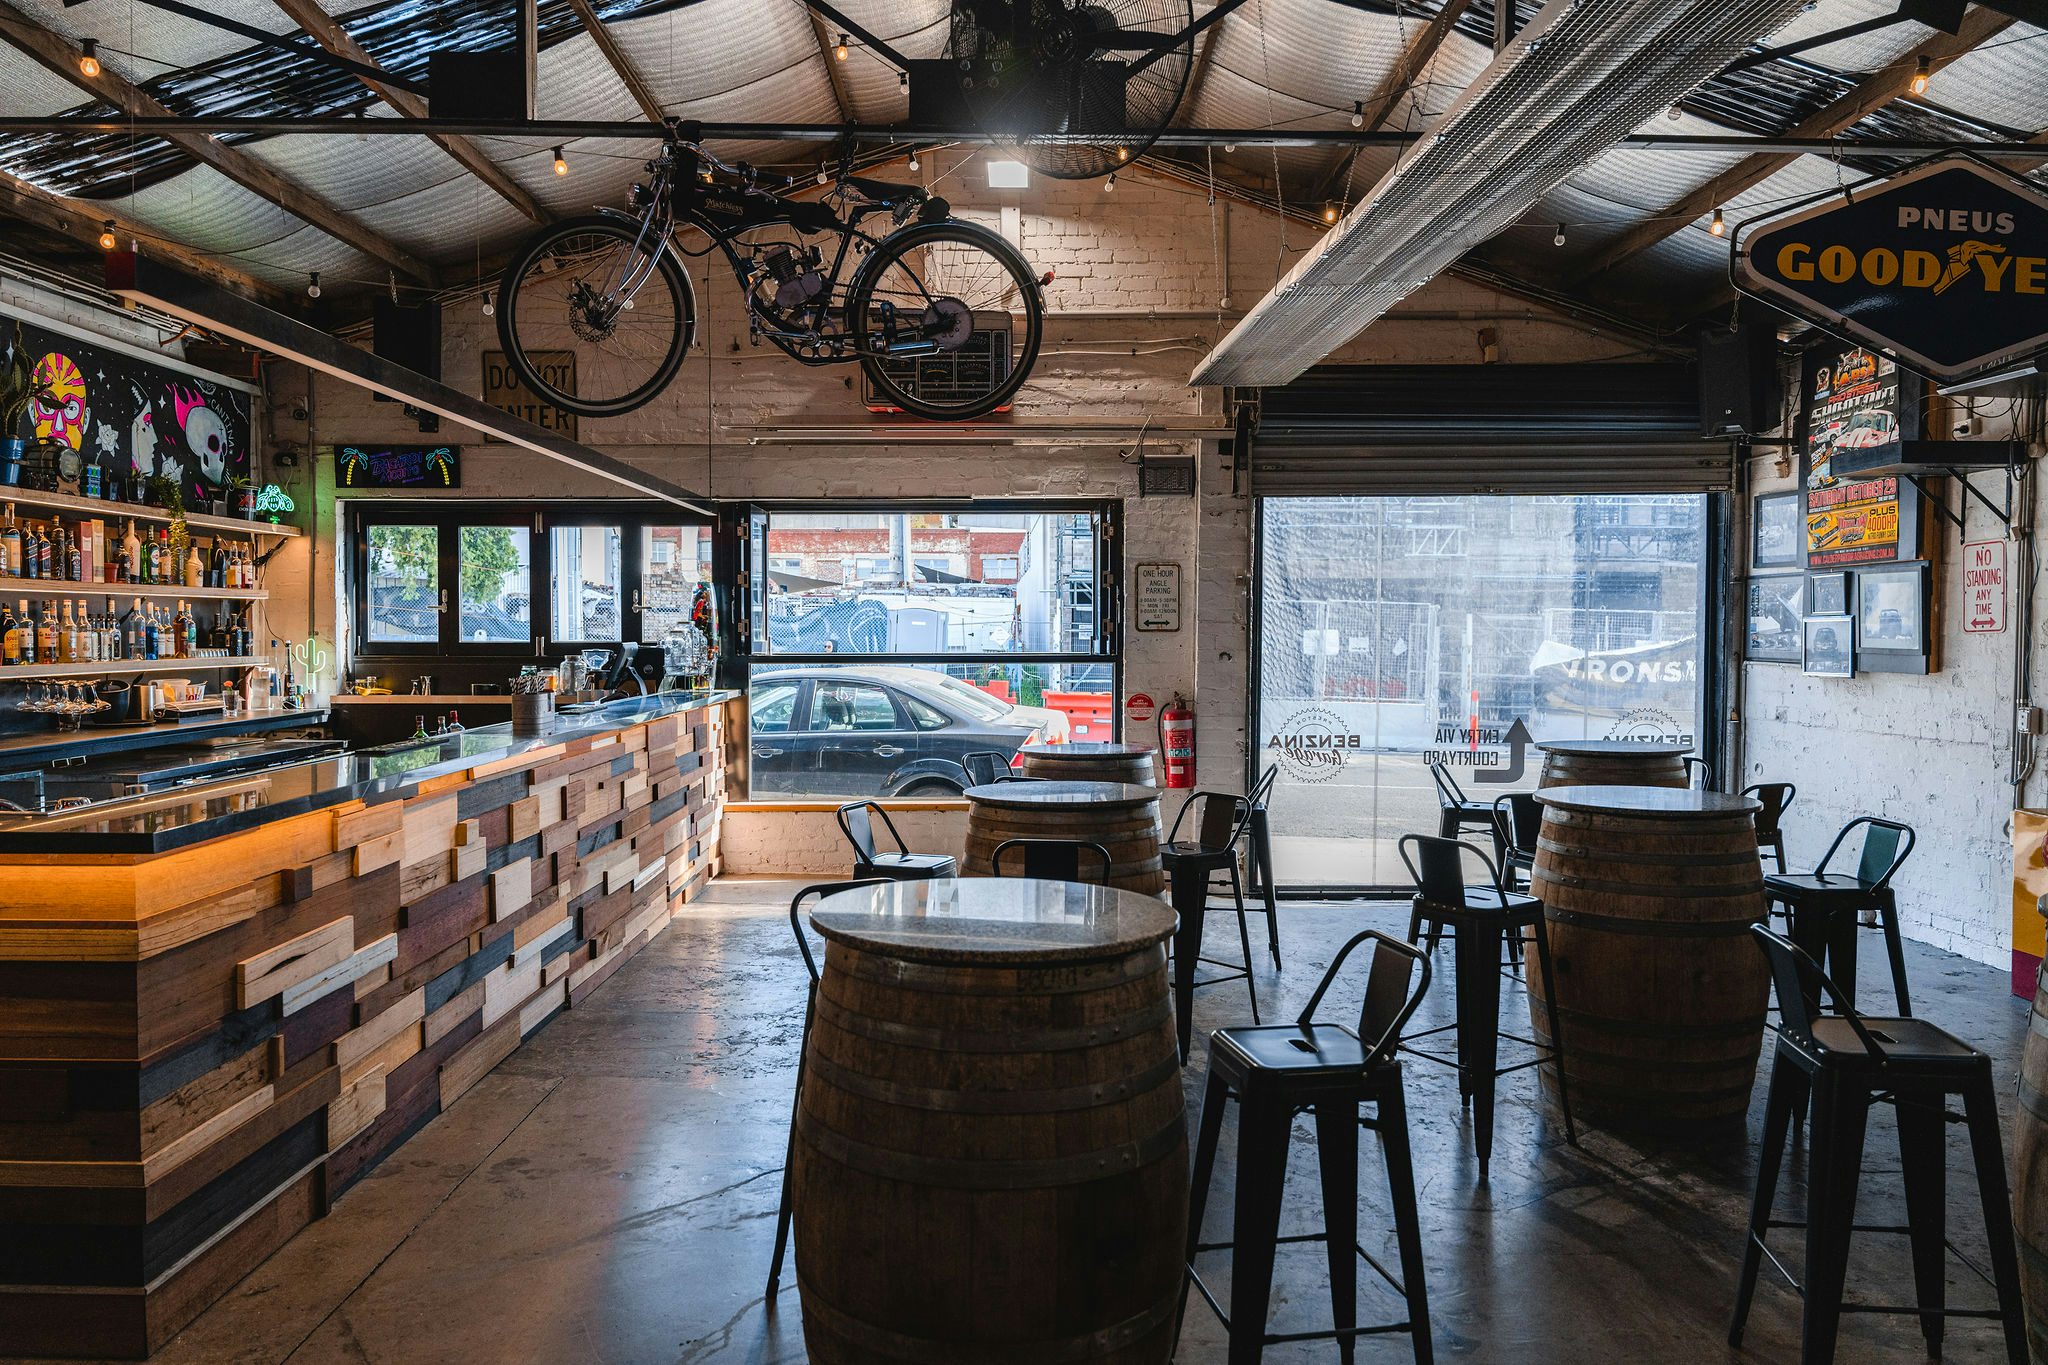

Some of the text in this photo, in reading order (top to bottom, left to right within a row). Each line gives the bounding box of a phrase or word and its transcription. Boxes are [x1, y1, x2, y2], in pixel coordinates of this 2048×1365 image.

[1897, 206, 2016, 235] PNEUS
[489, 365, 519, 391] DO
[1810, 384, 1899, 428] SHOOTOUT
[210, 398, 235, 450] CANTINA
[496, 404, 570, 430] TER
[1808, 486, 1846, 509] SATURDAY
[1847, 480, 1884, 502] OCTOBER
[1869, 505, 1896, 517] PLUS
[1866, 514, 1897, 532] 4000HP
[1976, 549, 1992, 566] NO
[1143, 569, 1174, 578] ONE HOUR
[1966, 568, 2001, 587] STANDING
[1145, 587, 1171, 595] PARKING
[1149, 579, 1168, 587] ANGLE
[1975, 589, 1992, 601] ANY
[1975, 603, 1992, 615] TIME
